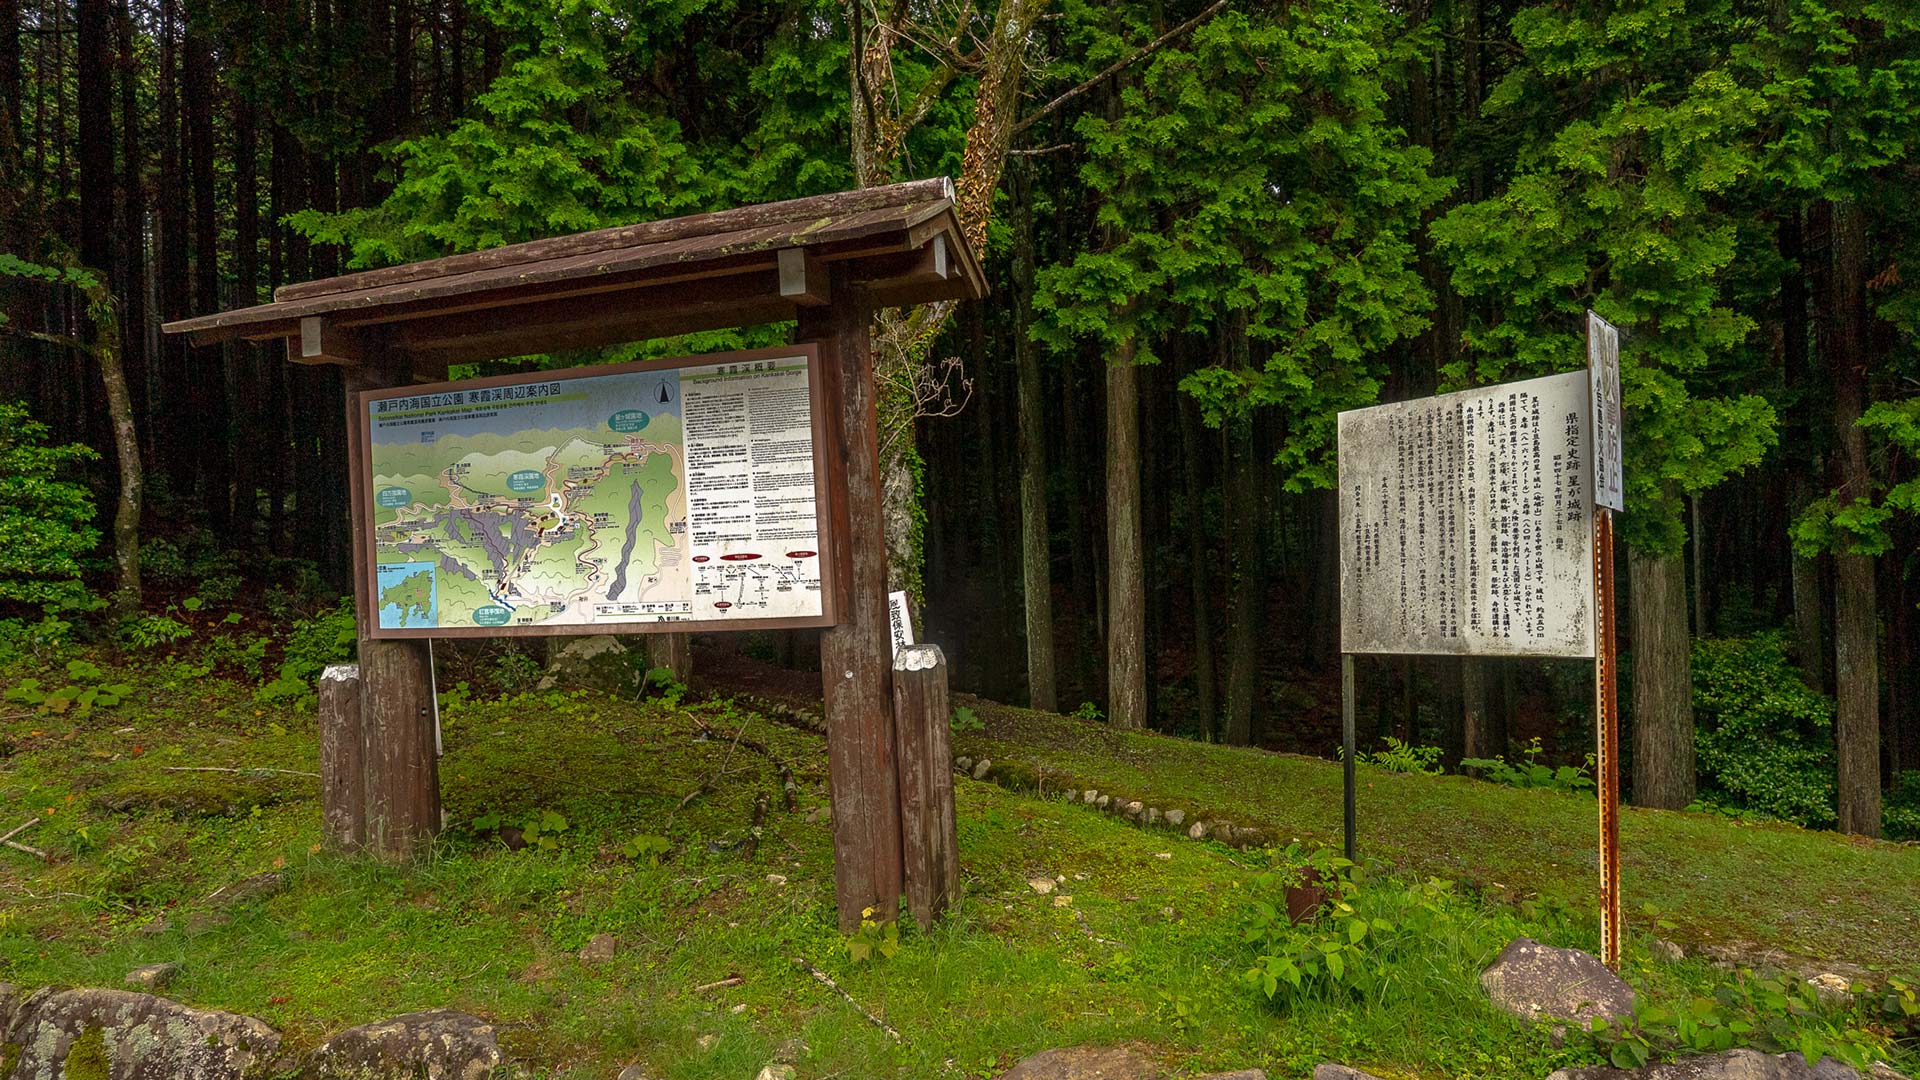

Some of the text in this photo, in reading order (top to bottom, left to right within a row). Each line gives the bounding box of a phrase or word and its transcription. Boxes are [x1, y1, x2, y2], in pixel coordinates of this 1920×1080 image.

[377, 394, 464, 413] 瀬戸内海国立公園
[469, 383, 561, 403] 寒霞渓周辺案内図
[1552, 454, 1564, 550] 昭和四十七年四月二十七日 指定
[1564, 411, 1582, 522] 県指定史跡 星が城跡
